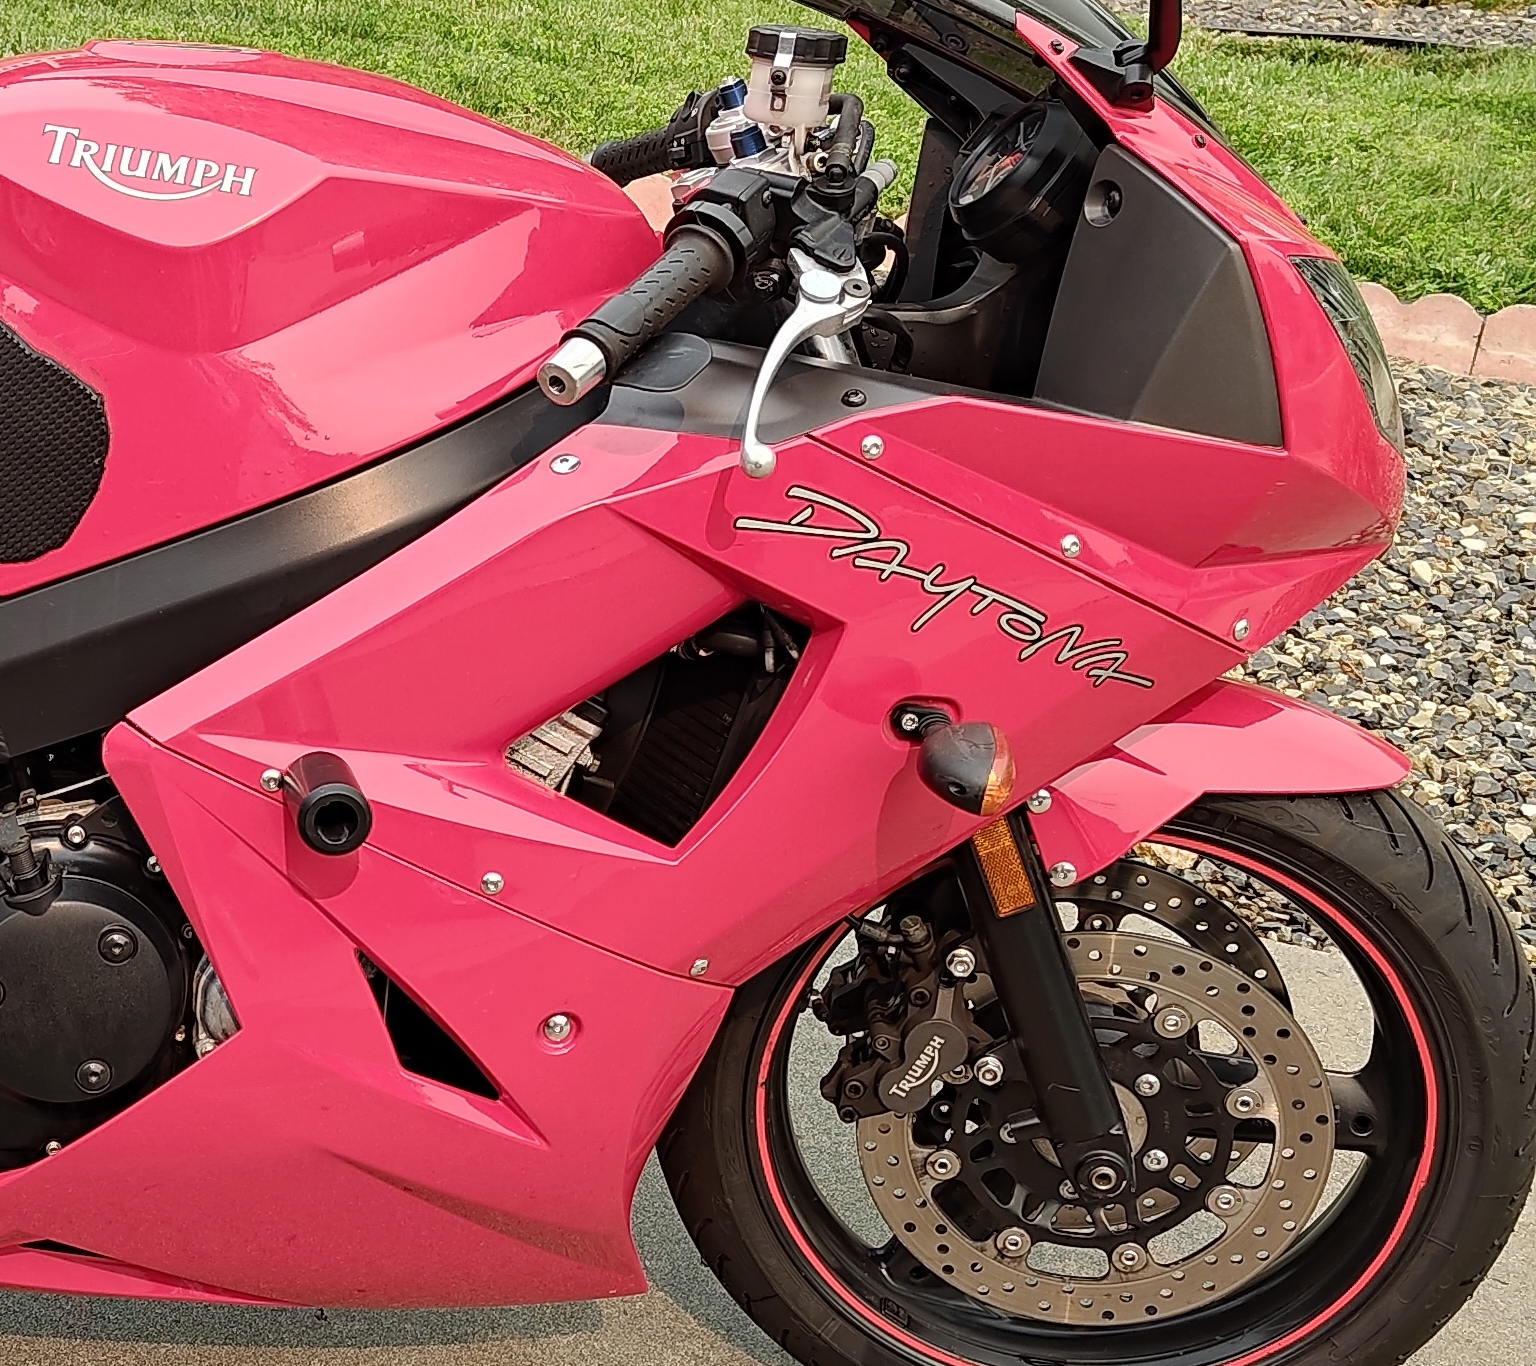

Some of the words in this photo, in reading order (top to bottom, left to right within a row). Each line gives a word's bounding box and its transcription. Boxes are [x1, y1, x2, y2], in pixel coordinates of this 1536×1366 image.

[41, 122, 259, 202] TRIUMPH
[734, 485, 1154, 688] DAYTONA
[888, 1034, 947, 1098] TRIUMPH
